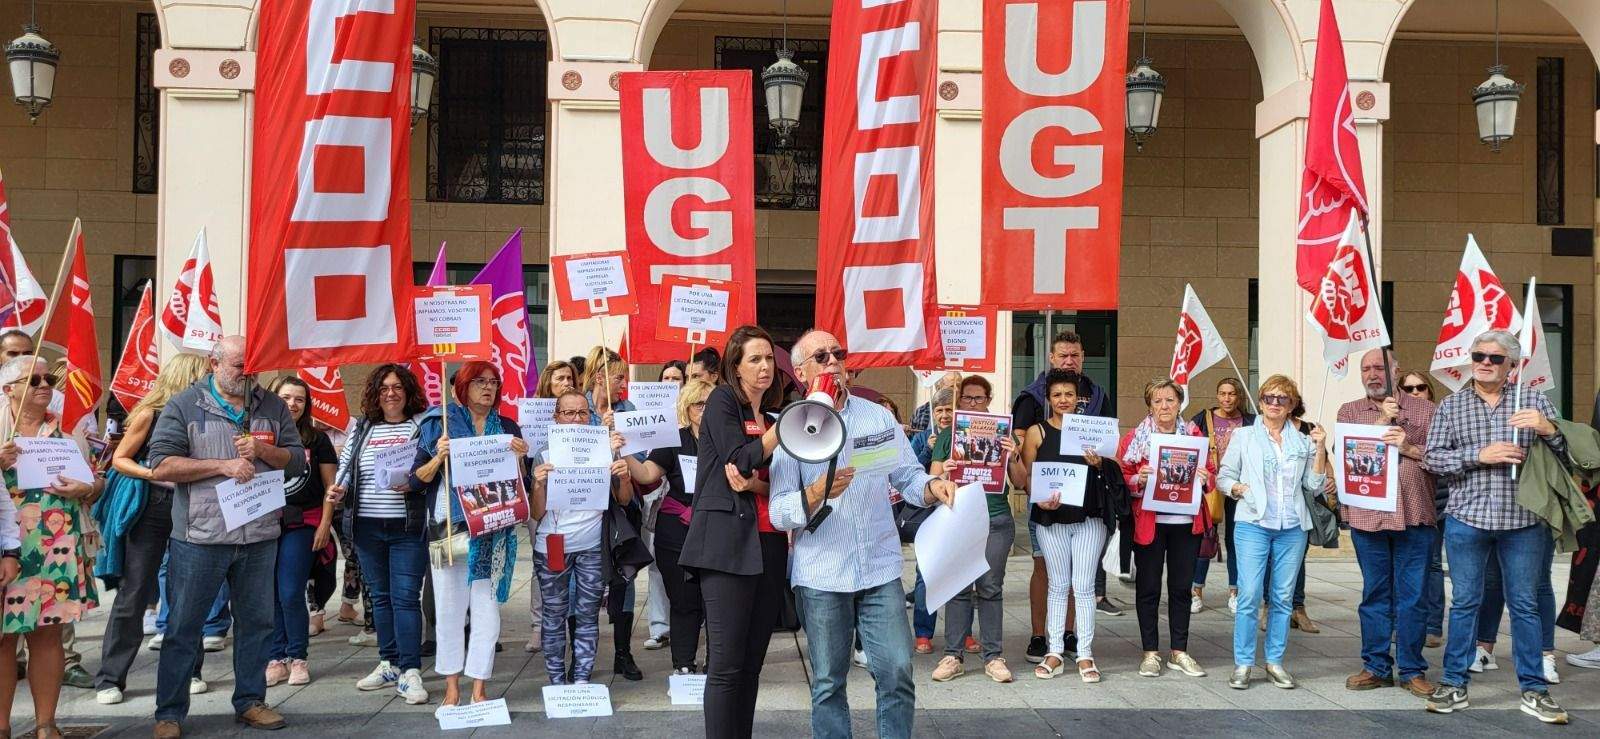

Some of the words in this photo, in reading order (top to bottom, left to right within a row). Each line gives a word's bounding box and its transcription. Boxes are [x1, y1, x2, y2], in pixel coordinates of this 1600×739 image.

[999, 1, 1104, 294] UGT
[642, 87, 733, 284] UG
[844, 0, 926, 353] COO
[626, 416, 648, 427] SMI
[650, 414, 666, 424] YA
[454, 449, 488, 458] LICITACIÓN
[464, 458, 505, 467] RESPONSABLE
[1041, 467, 1059, 476] SMI
[1063, 468, 1076, 478] YA
[222, 484, 252, 503] LICITACIÓN
[254, 478, 280, 489] PÚBLICA
[234, 488, 272, 508] RESPONSABLE
